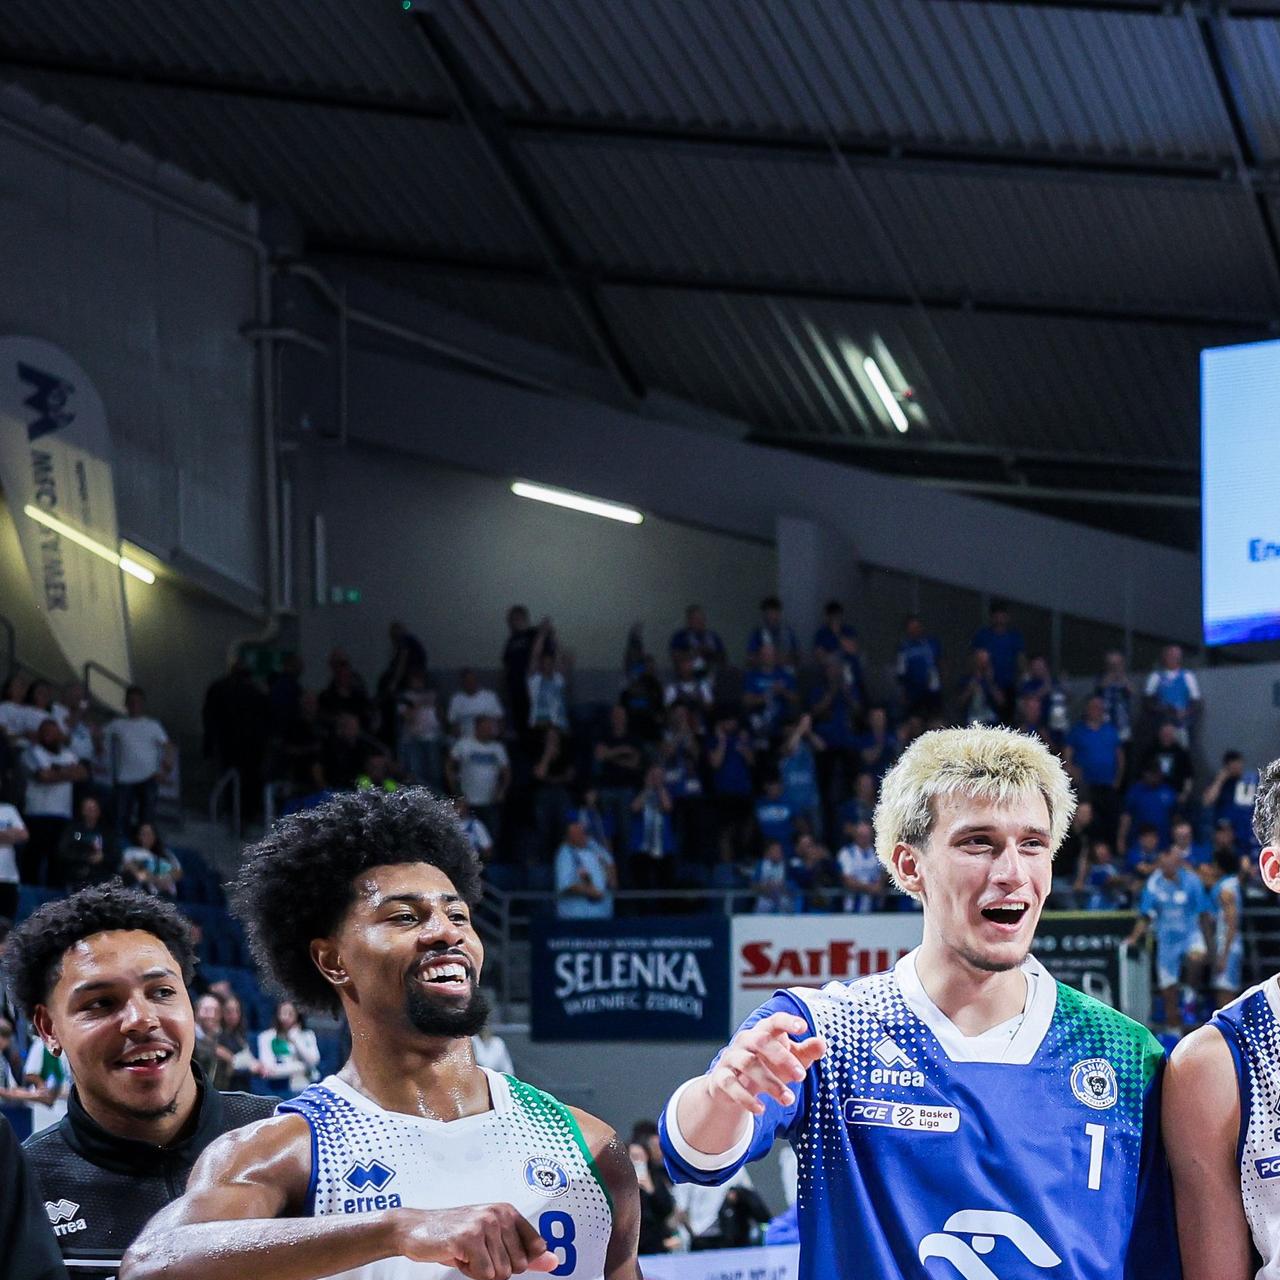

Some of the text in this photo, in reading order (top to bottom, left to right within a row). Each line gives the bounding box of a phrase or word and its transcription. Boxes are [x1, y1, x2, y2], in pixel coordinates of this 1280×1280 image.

[554, 950, 707, 998] SELENKA
[870, 1067, 925, 1088] errea
[1081, 1061, 1111, 1077] ANWIL
[851, 1104, 953, 1121] PGE Basket
[919, 1118, 940, 1129] Liga
[1084, 1122, 1107, 1191] 1
[344, 1193, 402, 1214] errea
[53, 1217, 87, 1236] rrea
[538, 1210, 578, 1277] 8
